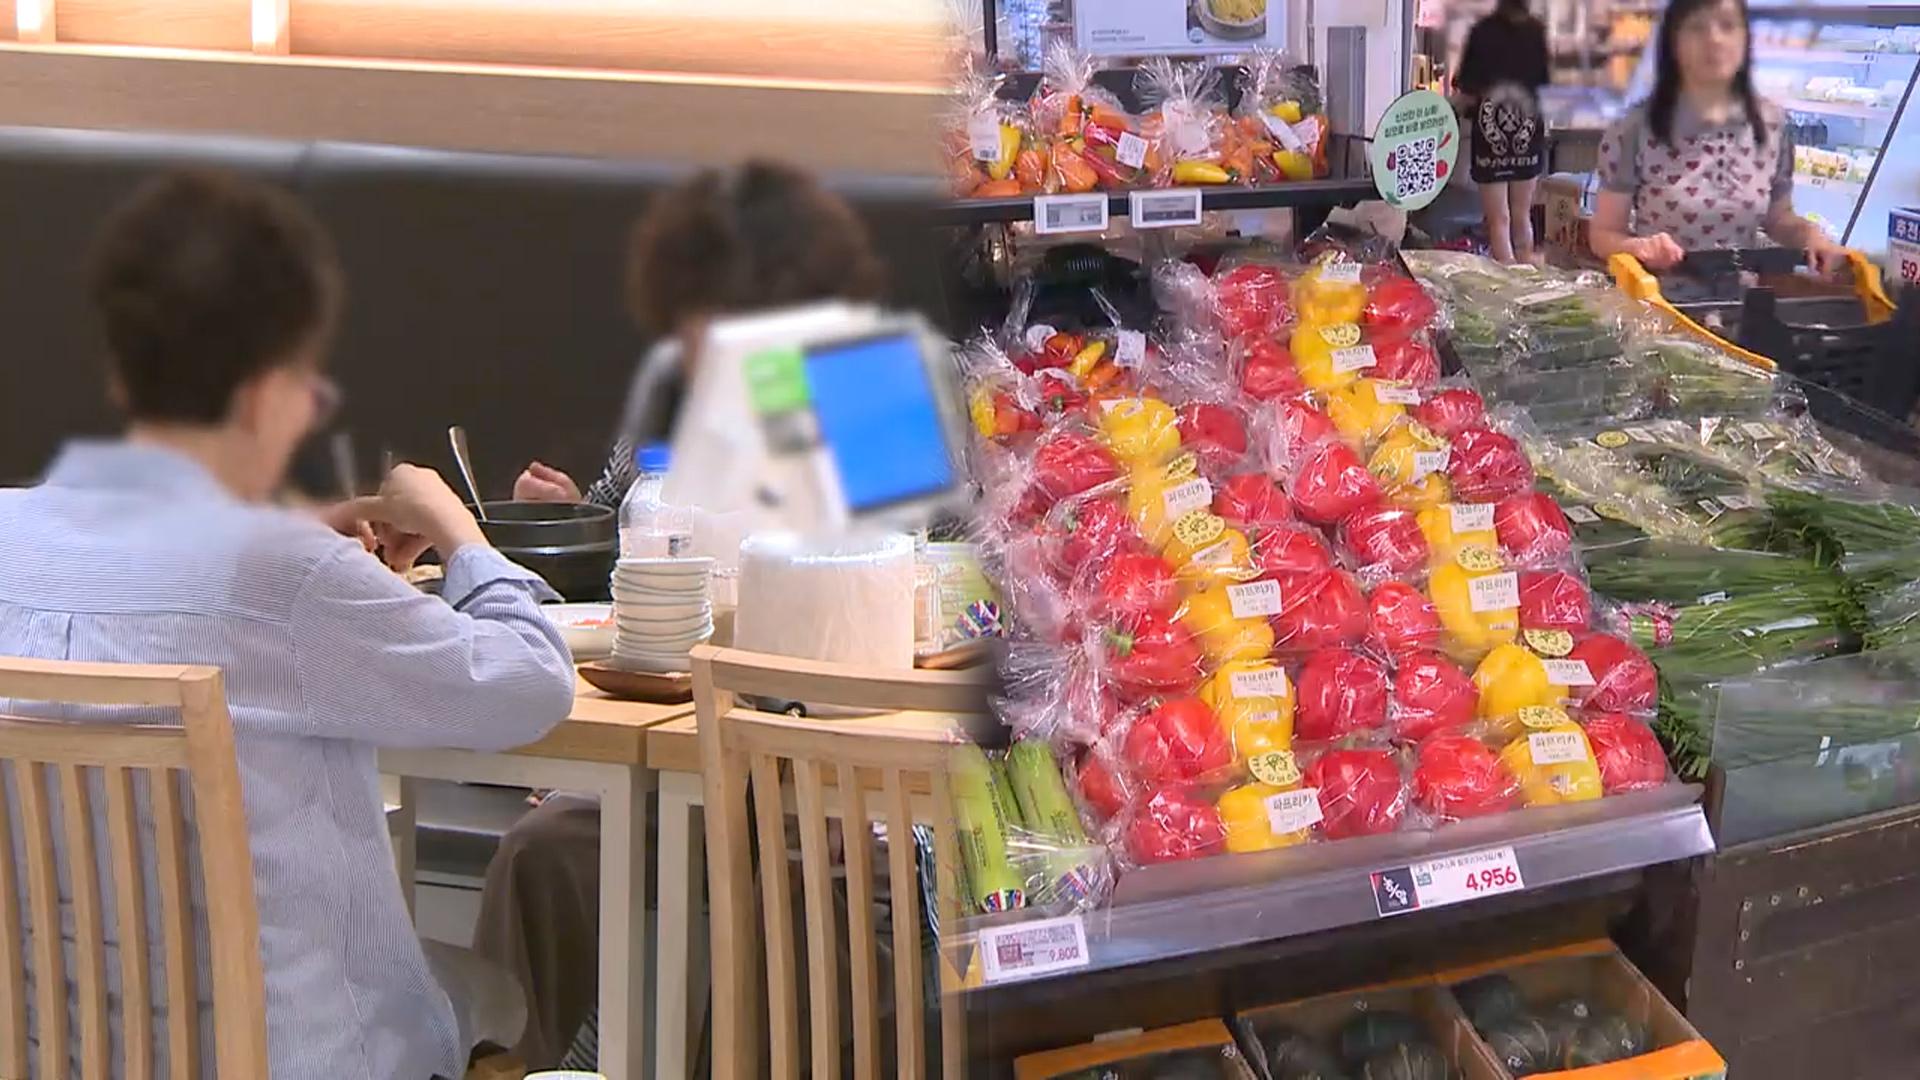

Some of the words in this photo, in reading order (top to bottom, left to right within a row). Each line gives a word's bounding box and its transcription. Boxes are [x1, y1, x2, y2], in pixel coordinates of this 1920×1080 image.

[1901, 258, 1920, 285] 59,
[1273, 793, 1313, 811] 파프리카
[1466, 866, 1517, 892] 4,956
